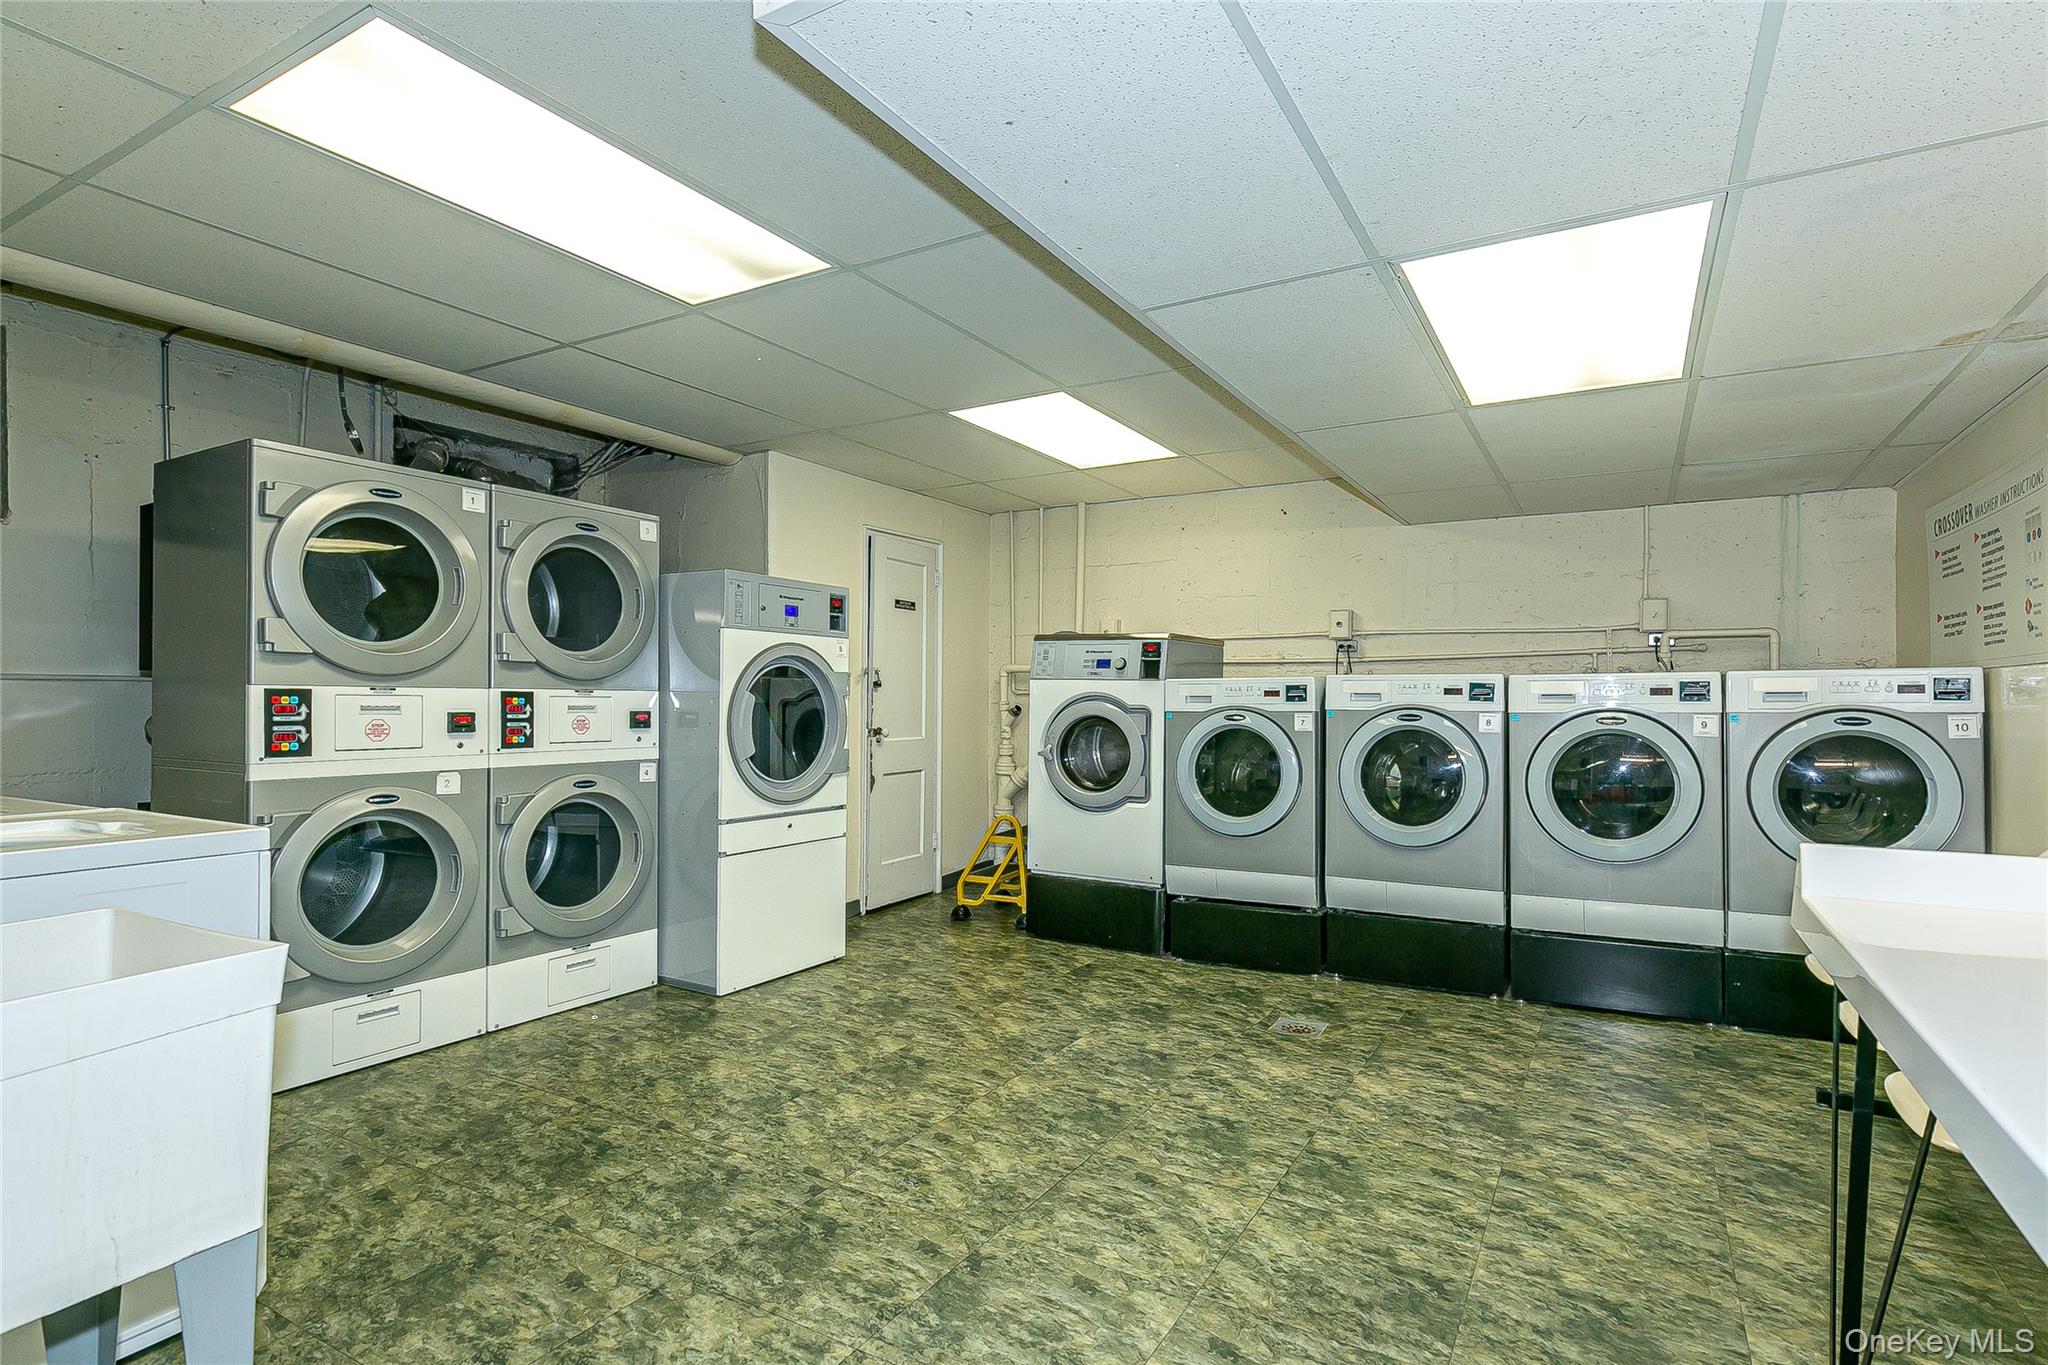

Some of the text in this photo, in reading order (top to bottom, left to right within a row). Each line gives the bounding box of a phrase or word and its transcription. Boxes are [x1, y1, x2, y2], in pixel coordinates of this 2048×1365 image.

[1933, 467, 2044, 537] CROSSOVER WASHER INSTRUCTIONS
[1700, 720, 1707, 729] 9
[1954, 722, 1969, 732] 10
[444, 779, 450, 788] 2
